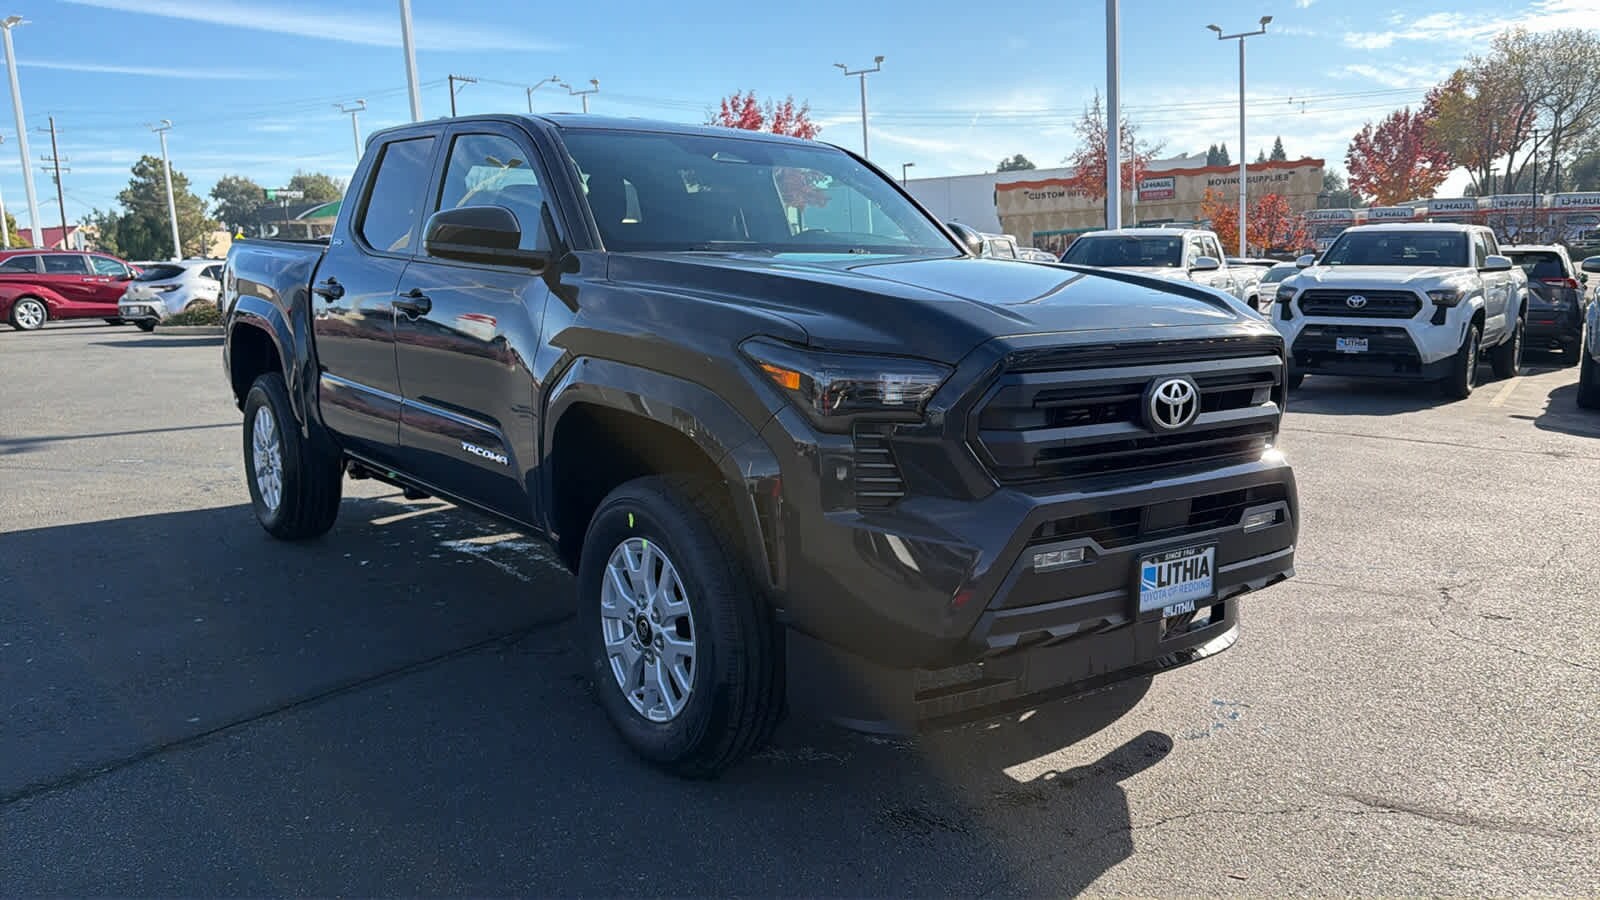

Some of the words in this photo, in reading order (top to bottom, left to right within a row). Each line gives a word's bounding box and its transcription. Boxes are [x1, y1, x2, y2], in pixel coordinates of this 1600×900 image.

[1375, 209, 1408, 218] U-HAUL
[1434, 202, 1473, 211] U-HAUL
[461, 441, 508, 466] TACOMA
[1165, 550, 1181, 561] SINCE
[1157, 555, 1210, 588] LITHIA
[1179, 579, 1211, 593] REDDING
[1170, 600, 1195, 615] LITHIA
